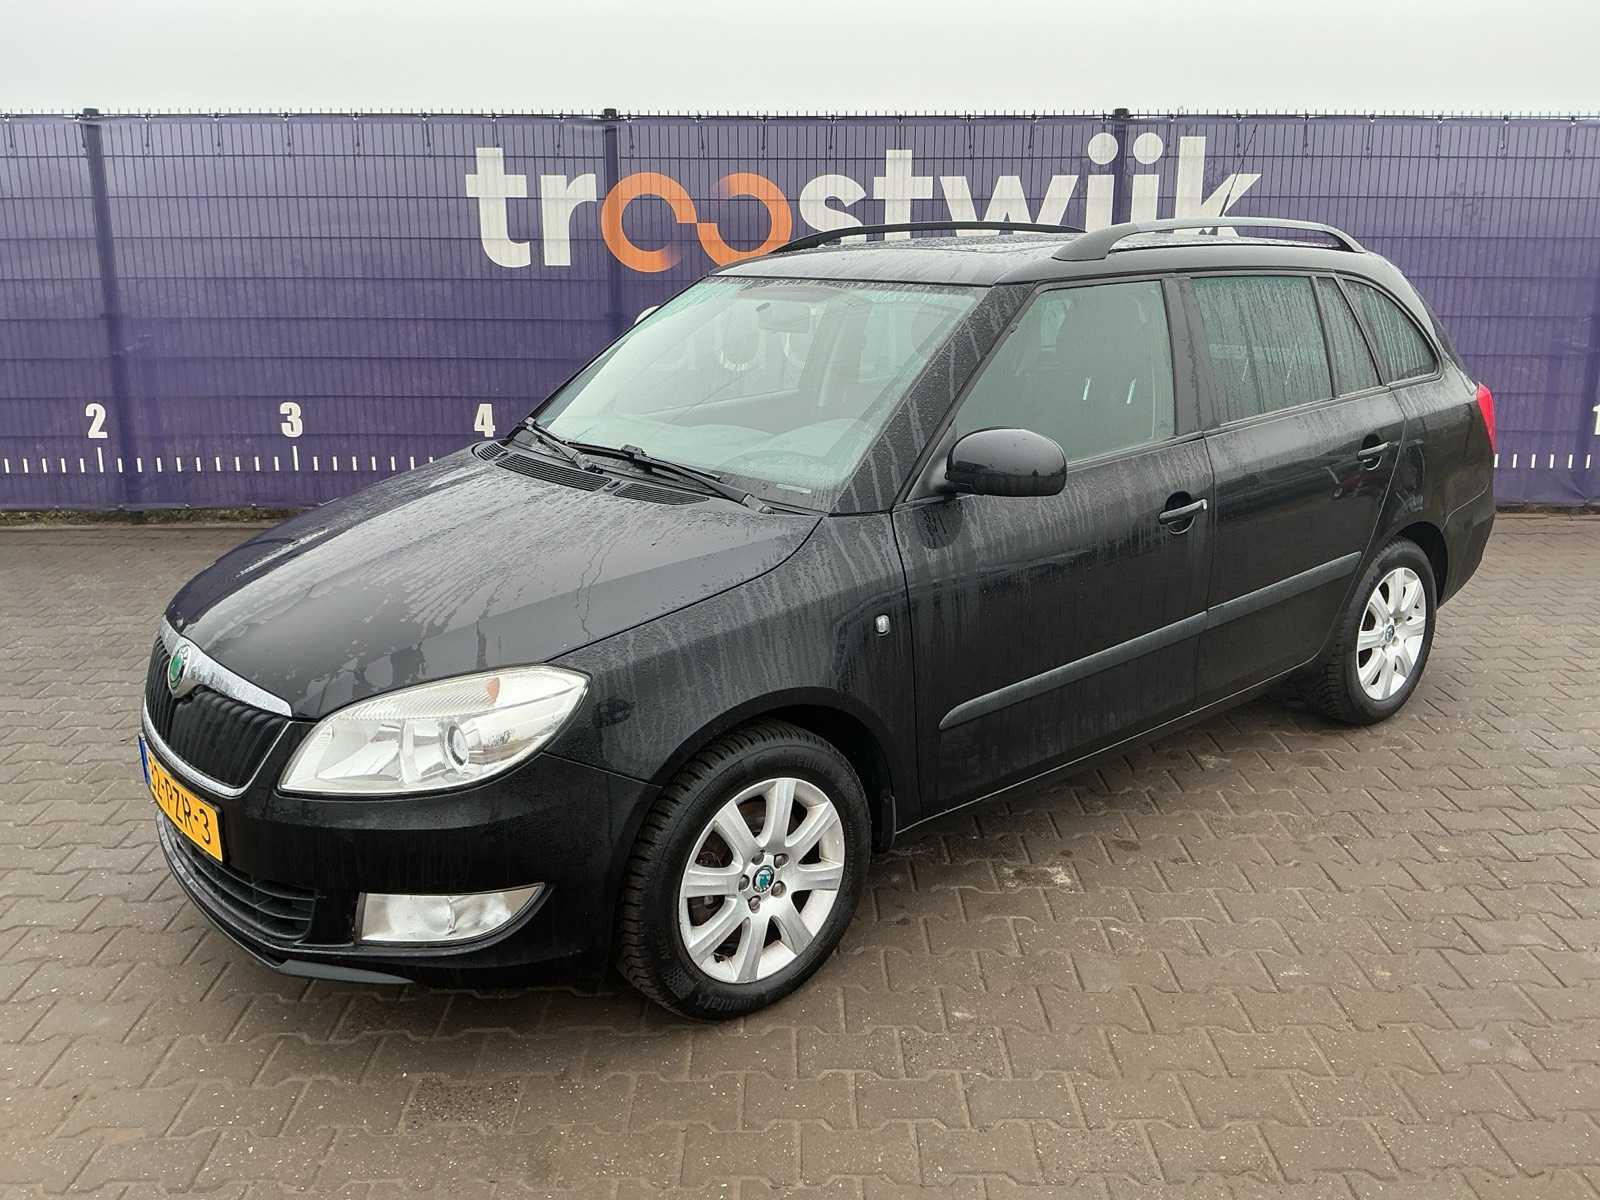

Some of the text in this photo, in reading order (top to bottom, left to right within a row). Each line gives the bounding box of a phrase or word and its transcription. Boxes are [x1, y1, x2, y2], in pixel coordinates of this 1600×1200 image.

[465, 132, 1262, 274] troostwijk
[86, 403, 108, 439] 2
[280, 402, 304, 438] 3
[474, 403, 496, 438] 4
